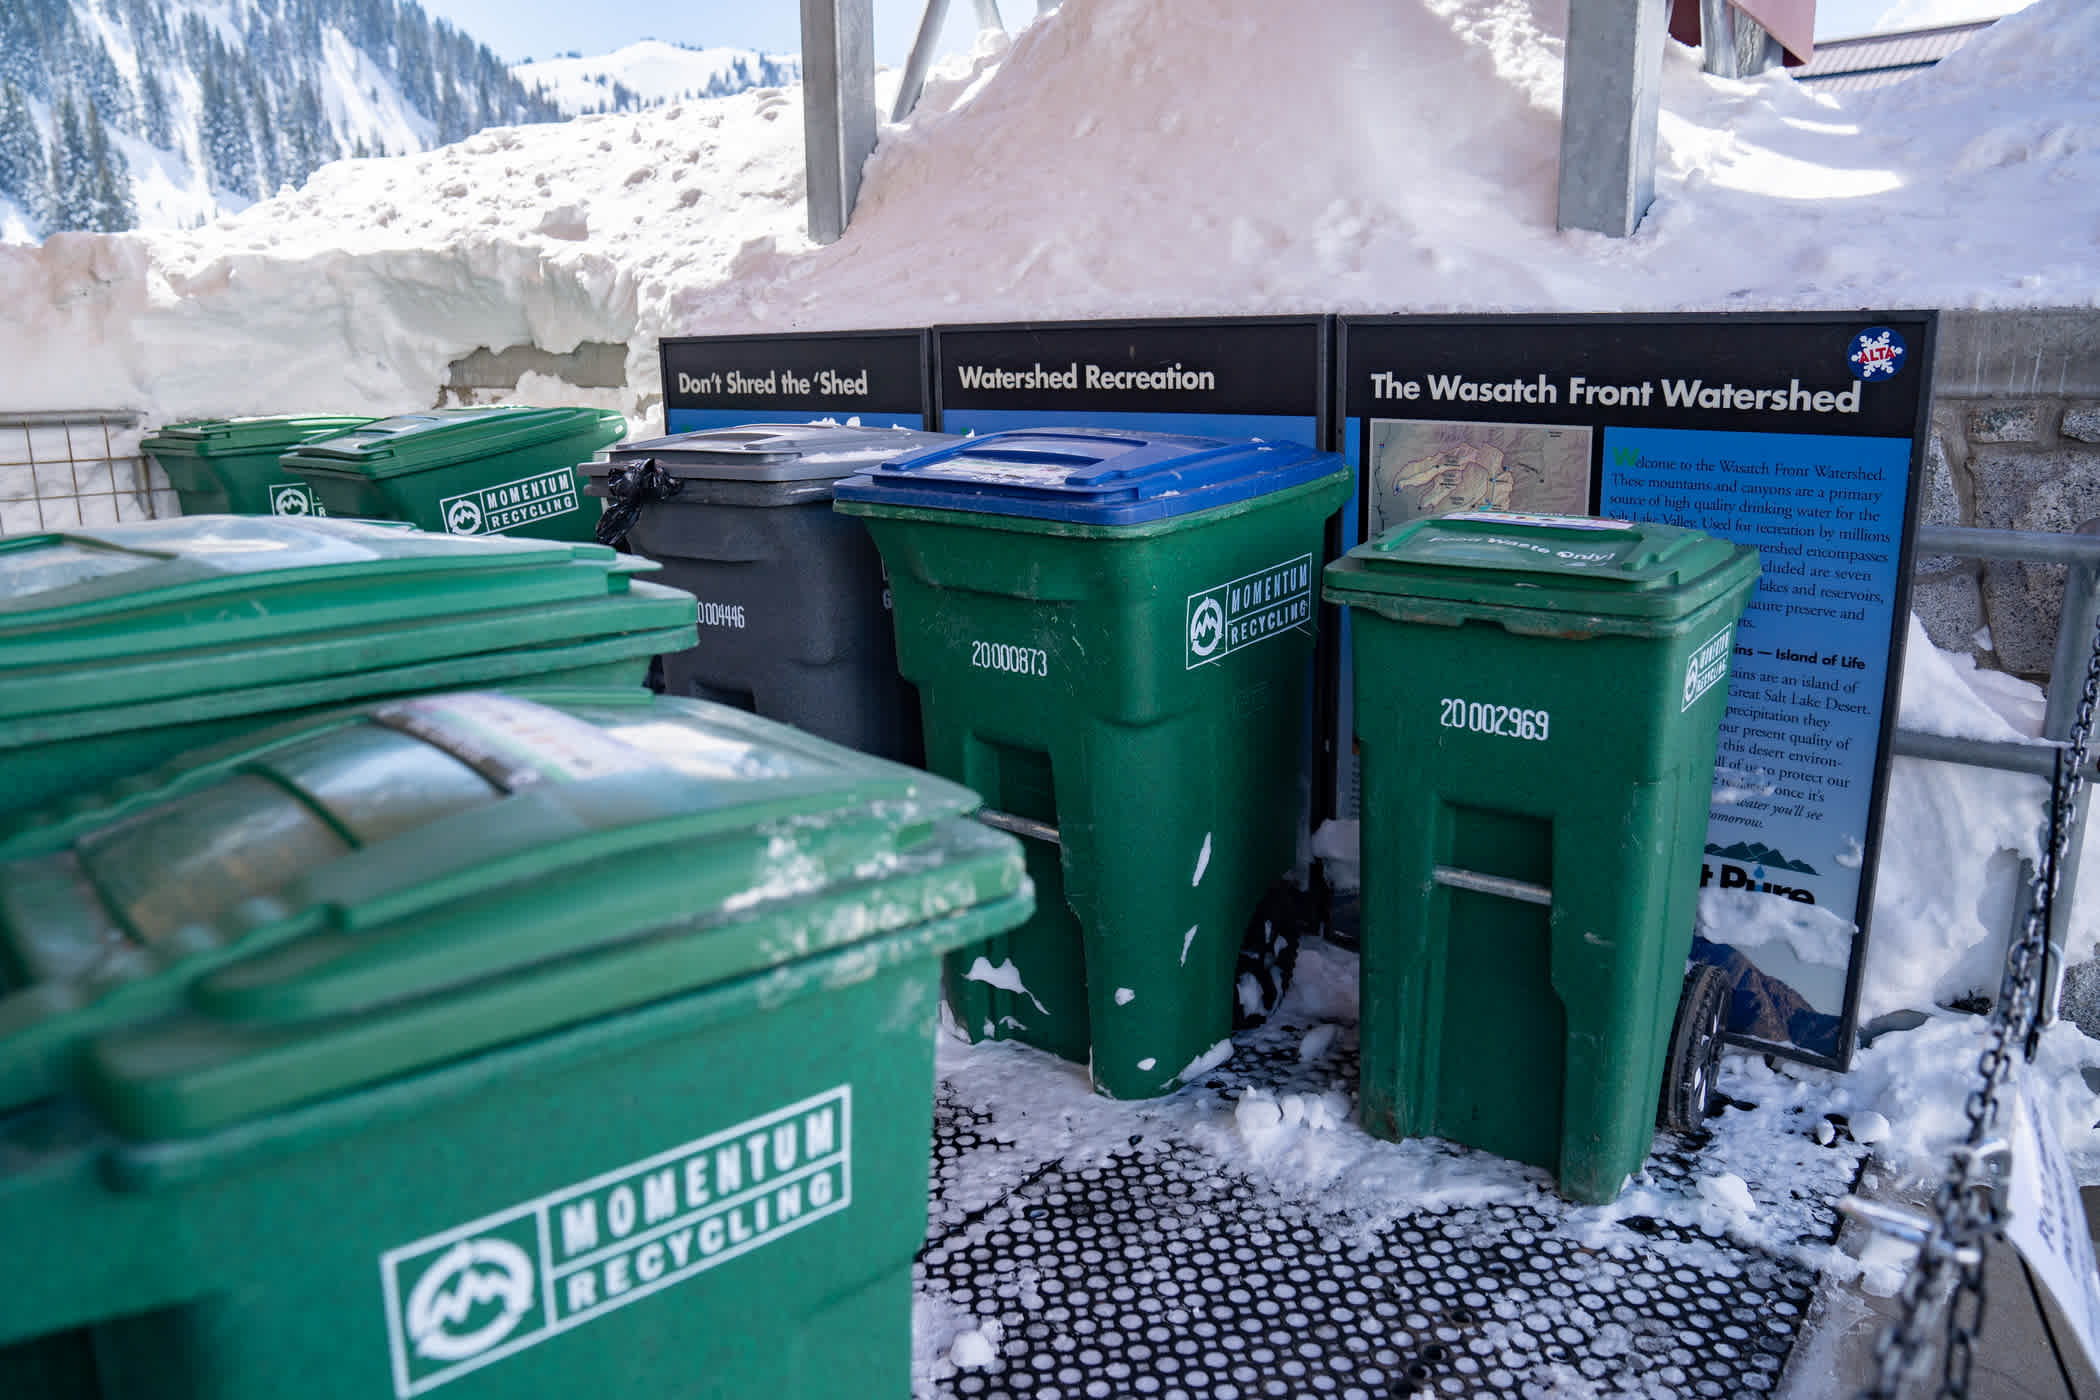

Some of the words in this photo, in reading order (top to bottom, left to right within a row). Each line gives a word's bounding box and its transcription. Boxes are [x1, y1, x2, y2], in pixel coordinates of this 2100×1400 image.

[1859, 347, 1896, 364] ALTA
[678, 372, 722, 394] Don't
[727, 370, 776, 394] Shred
[781, 370, 810, 394] the
[958, 363, 1078, 389] Watershed
[1085, 363, 1215, 390] Recreation
[1371, 371, 1420, 400] The
[1427, 374, 1557, 404] Wasatch
[1569, 377, 1653, 406] Front
[1661, 379, 1862, 413] Watershed
[1612, 446, 1677, 471] Welcome
[1680, 461, 1692, 472] to
[1696, 459, 1716, 472] the
[1719, 460, 1769, 475] Wasatch
[1775, 463, 1809, 477] Front
[1814, 464, 1887, 481] Watershed.
[487, 474, 569, 510] MOMENTUM
[1610, 472, 1645, 488] These
[1648, 480, 1712, 492] mountains
[1714, 480, 1737, 493] and
[1741, 484, 1792, 498] canyons
[1795, 487, 1814, 497] are
[1818, 488, 1825, 498] a
[1829, 488, 1882, 504] primary
[491, 496, 573, 528] RECYCLING
[1609, 495, 1646, 505] source
[1649, 494, 1660, 505] of
[1665, 495, 1690, 512] high
[1694, 498, 1736, 513] quality
[1739, 499, 1793, 519] drinking
[1797, 507, 1832, 519] water
[1836, 506, 1855, 520] for
[1859, 507, 1880, 522] the
[1702, 516, 1731, 531] Used
[1735, 518, 1753, 532] for
[1756, 521, 1815, 537] recreation
[1819, 523, 1834, 541] by
[1839, 527, 1891, 543] millions
[1487, 538, 1550, 553] Waste
[1556, 551, 1616, 562] Only!
[1806, 549, 1889, 565] encompasses
[1761, 560, 1805, 576] cluded
[1810, 567, 1831, 578] are
[1835, 570, 1872, 582] seven
[1231, 564, 1307, 614] MOMENTUM
[1759, 578, 1788, 593] lakes
[1792, 584, 1816, 597] and
[1821, 587, 1884, 605] reservoirs,
[696, 602, 745, 628] 0004446
[1231, 600, 1308, 645] RECYCLING
[1785, 602, 1837, 617] preserve
[1840, 608, 1865, 621] and
[1776, 647, 1818, 664] Island
[1822, 654, 1838, 666] of
[1841, 656, 1866, 670] Life
[1760, 673, 1778, 684] are
[1781, 676, 1797, 687] an
[1802, 676, 1839, 692] island
[1843, 681, 1859, 694] of
[1728, 684, 1760, 700] Great
[1764, 687, 1786, 704] Salt
[1792, 691, 1820, 708] Lake
[1825, 697, 1871, 715] Desert.
[1726, 704, 1799, 724] precipitation
[1803, 712, 1831, 729] they
[1719, 723, 1739, 733] our
[1742, 726, 1785, 740] present
[1789, 733, 1832, 750] quality
[1836, 737, 1852, 751] of
[1723, 738, 1745, 752] this
[1748, 743, 1785, 759] desert
[1788, 751, 1843, 768] environ-
[1728, 759, 1744, 771] of
[1779, 768, 1823, 782] protect
[1826, 776, 1850, 788] our
[1774, 788, 1805, 799] once
[1808, 790, 1824, 802] it's
[1708, 811, 1763, 828] omorrow.
[1770, 803, 1804, 817] you'll
[1806, 811, 1824, 820] see
[562, 1107, 833, 1257] MOMENTUM
[567, 1171, 833, 1312] RECYCLING
